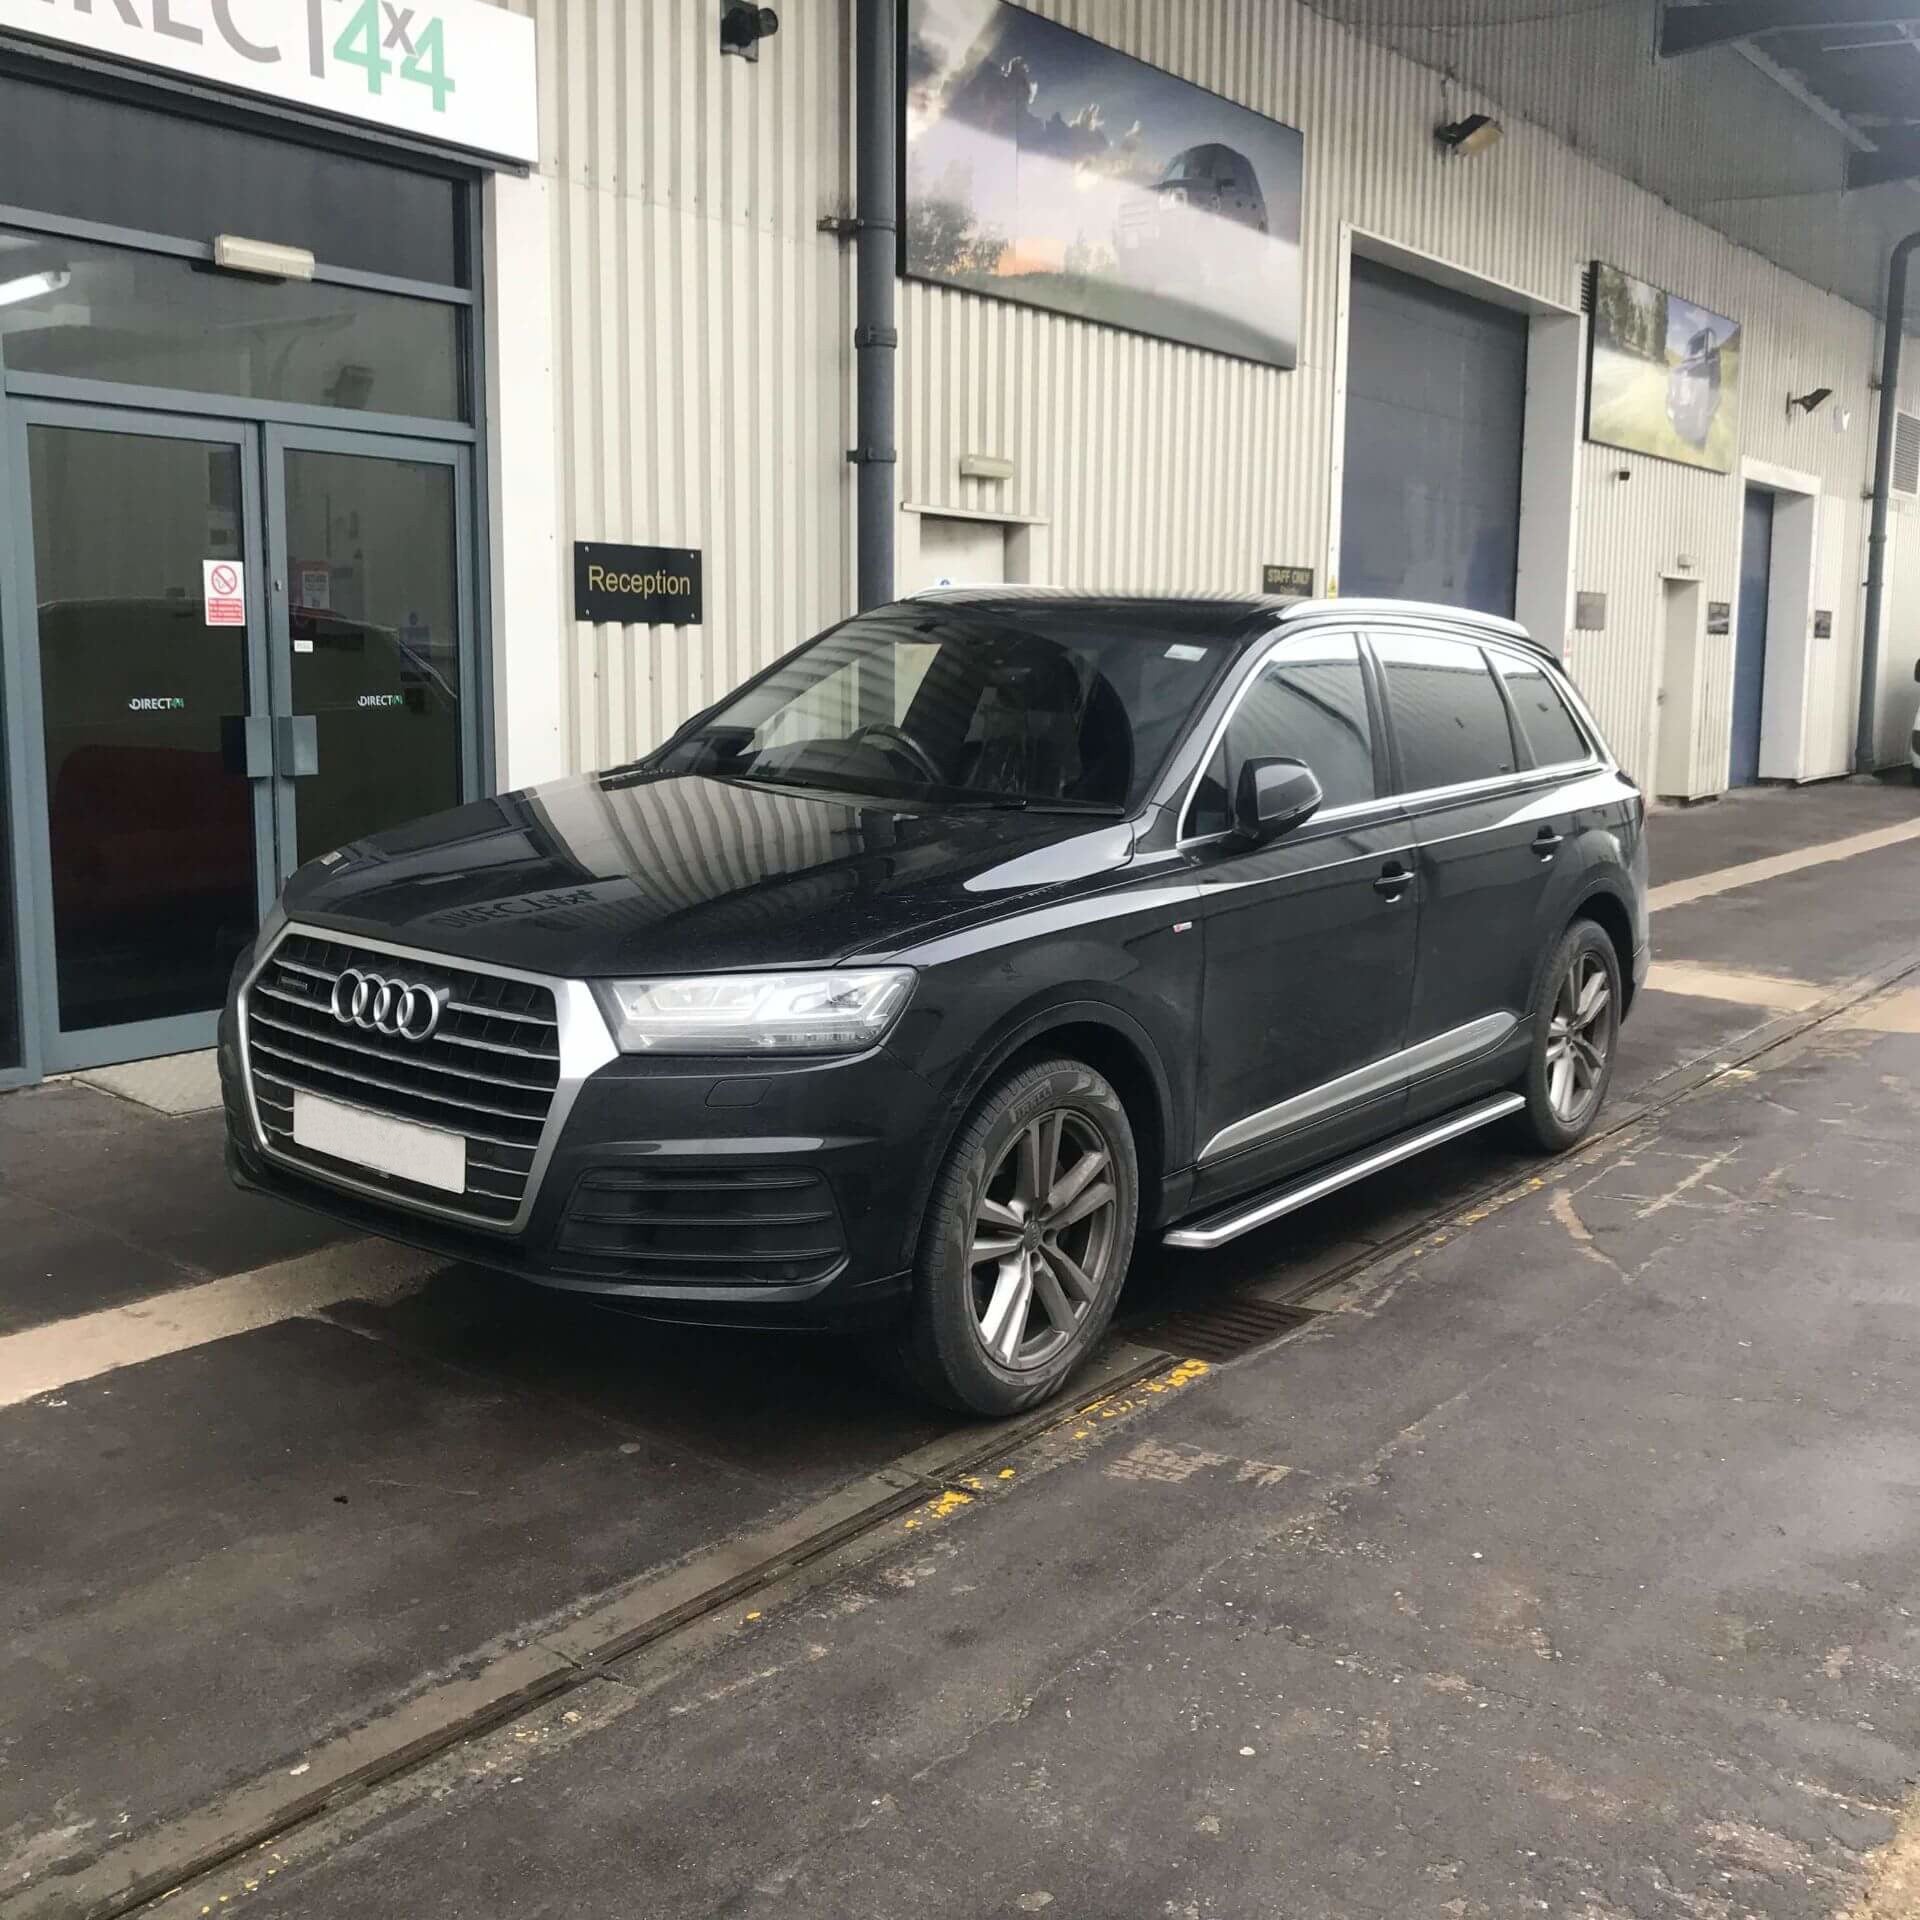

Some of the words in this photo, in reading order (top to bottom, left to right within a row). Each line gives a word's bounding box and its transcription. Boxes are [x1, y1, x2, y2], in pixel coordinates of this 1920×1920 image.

[588, 564, 690, 600] Reception
[1267, 567, 1290, 584] STAFF
[357, 694, 403, 706] DIRECT
